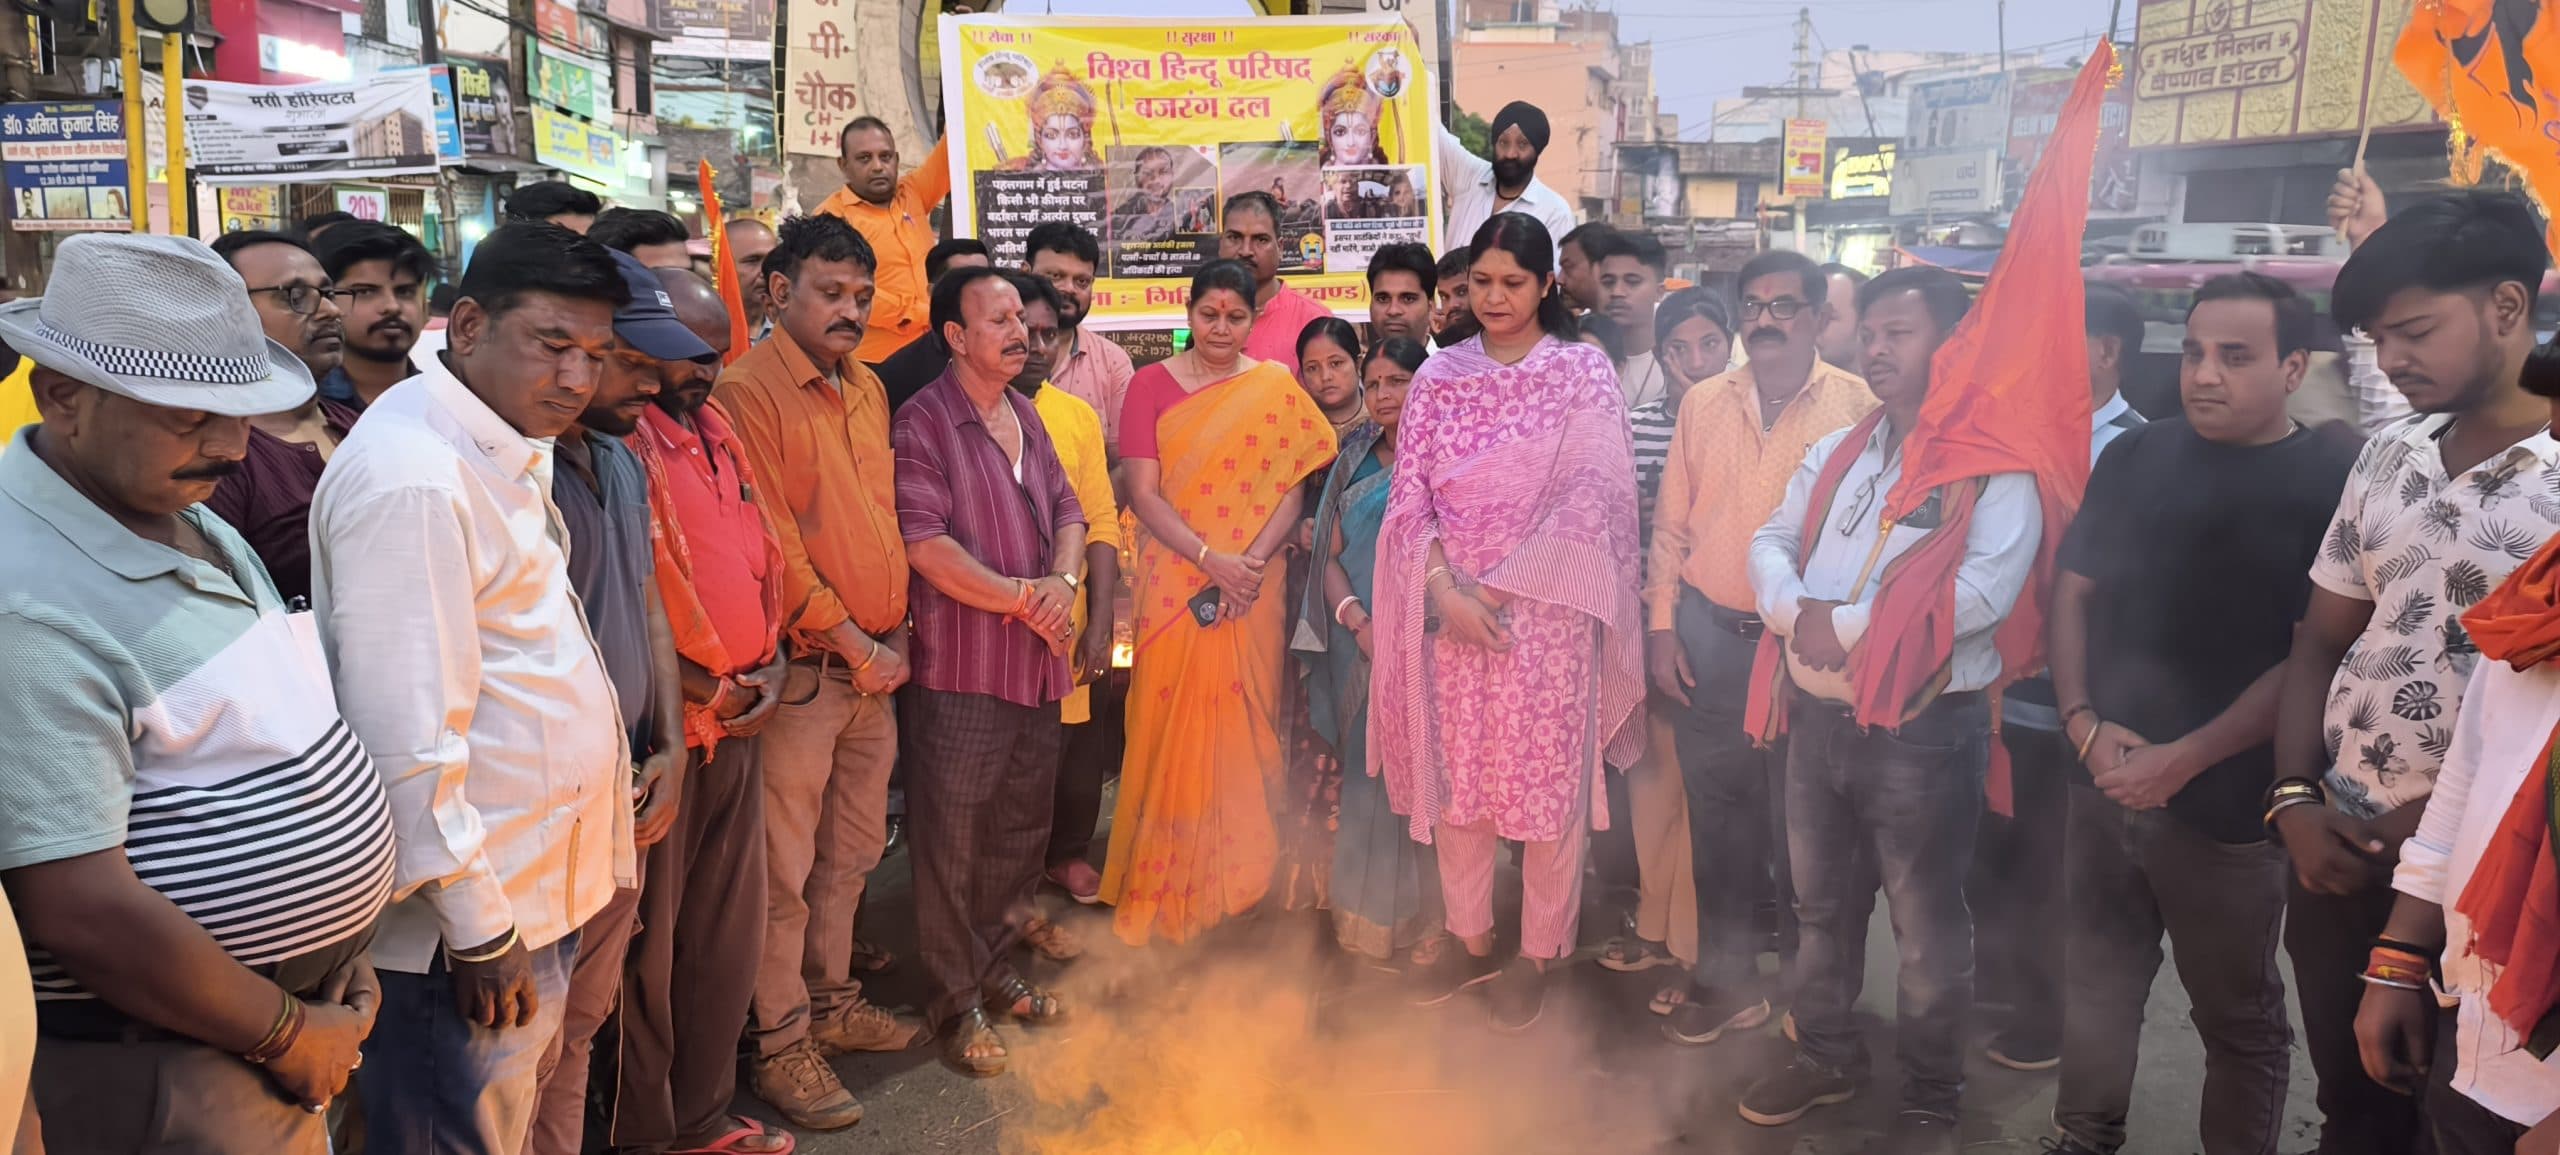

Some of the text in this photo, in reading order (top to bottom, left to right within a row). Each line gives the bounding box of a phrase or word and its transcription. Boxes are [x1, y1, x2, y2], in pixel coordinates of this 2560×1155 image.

[988, 31, 1014, 43] सेवा
[1182, 31, 1216, 47] सुरक्षा
[1087, 51, 1314, 87] विश्व हिन्दू परिषद्
[1135, 89, 1271, 119] बजरंग दल
[26, 112, 59, 135] अमित
[60, 115, 94, 139] कुमार
[95, 110, 119, 133] सिंह
[992, 177, 1088, 192] पहलगाम में हुई घटना
[227, 198, 263, 212] Cake
[996, 193, 1086, 206] किसी भी कीमत पर
[1020, 209, 1040, 223] नहीं
[987, 228, 1013, 238] भारत
